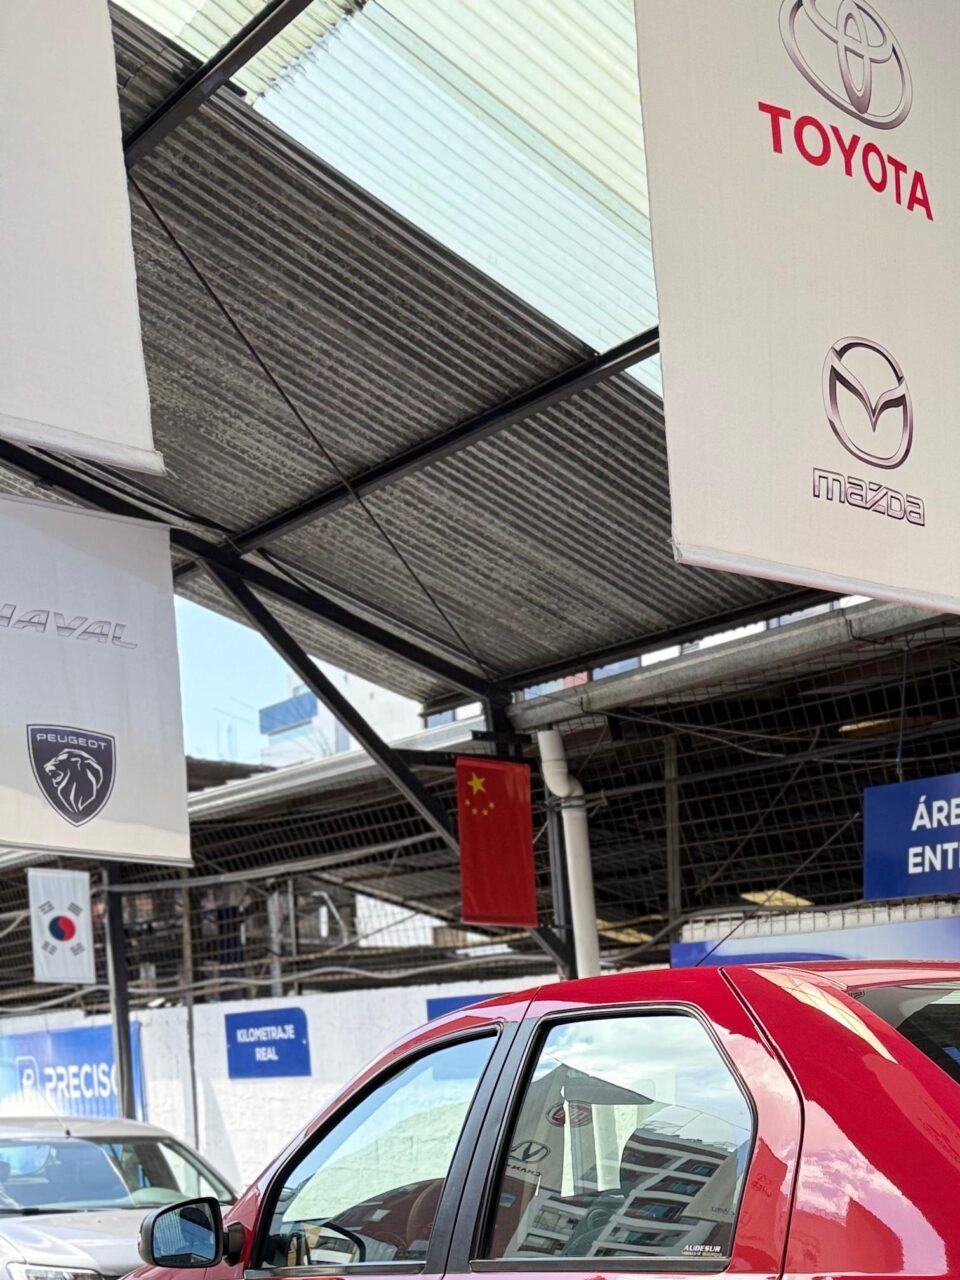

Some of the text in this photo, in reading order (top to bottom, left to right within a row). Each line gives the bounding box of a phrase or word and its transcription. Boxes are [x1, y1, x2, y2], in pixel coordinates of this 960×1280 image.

[757, 101, 934, 222] TOYOTA
[812, 467, 926, 527] mazda
[36, 733, 108, 750] PEUGEOT
[236, 1024, 296, 1043] KILOMETRAJE
[255, 1046, 279, 1062] REAL
